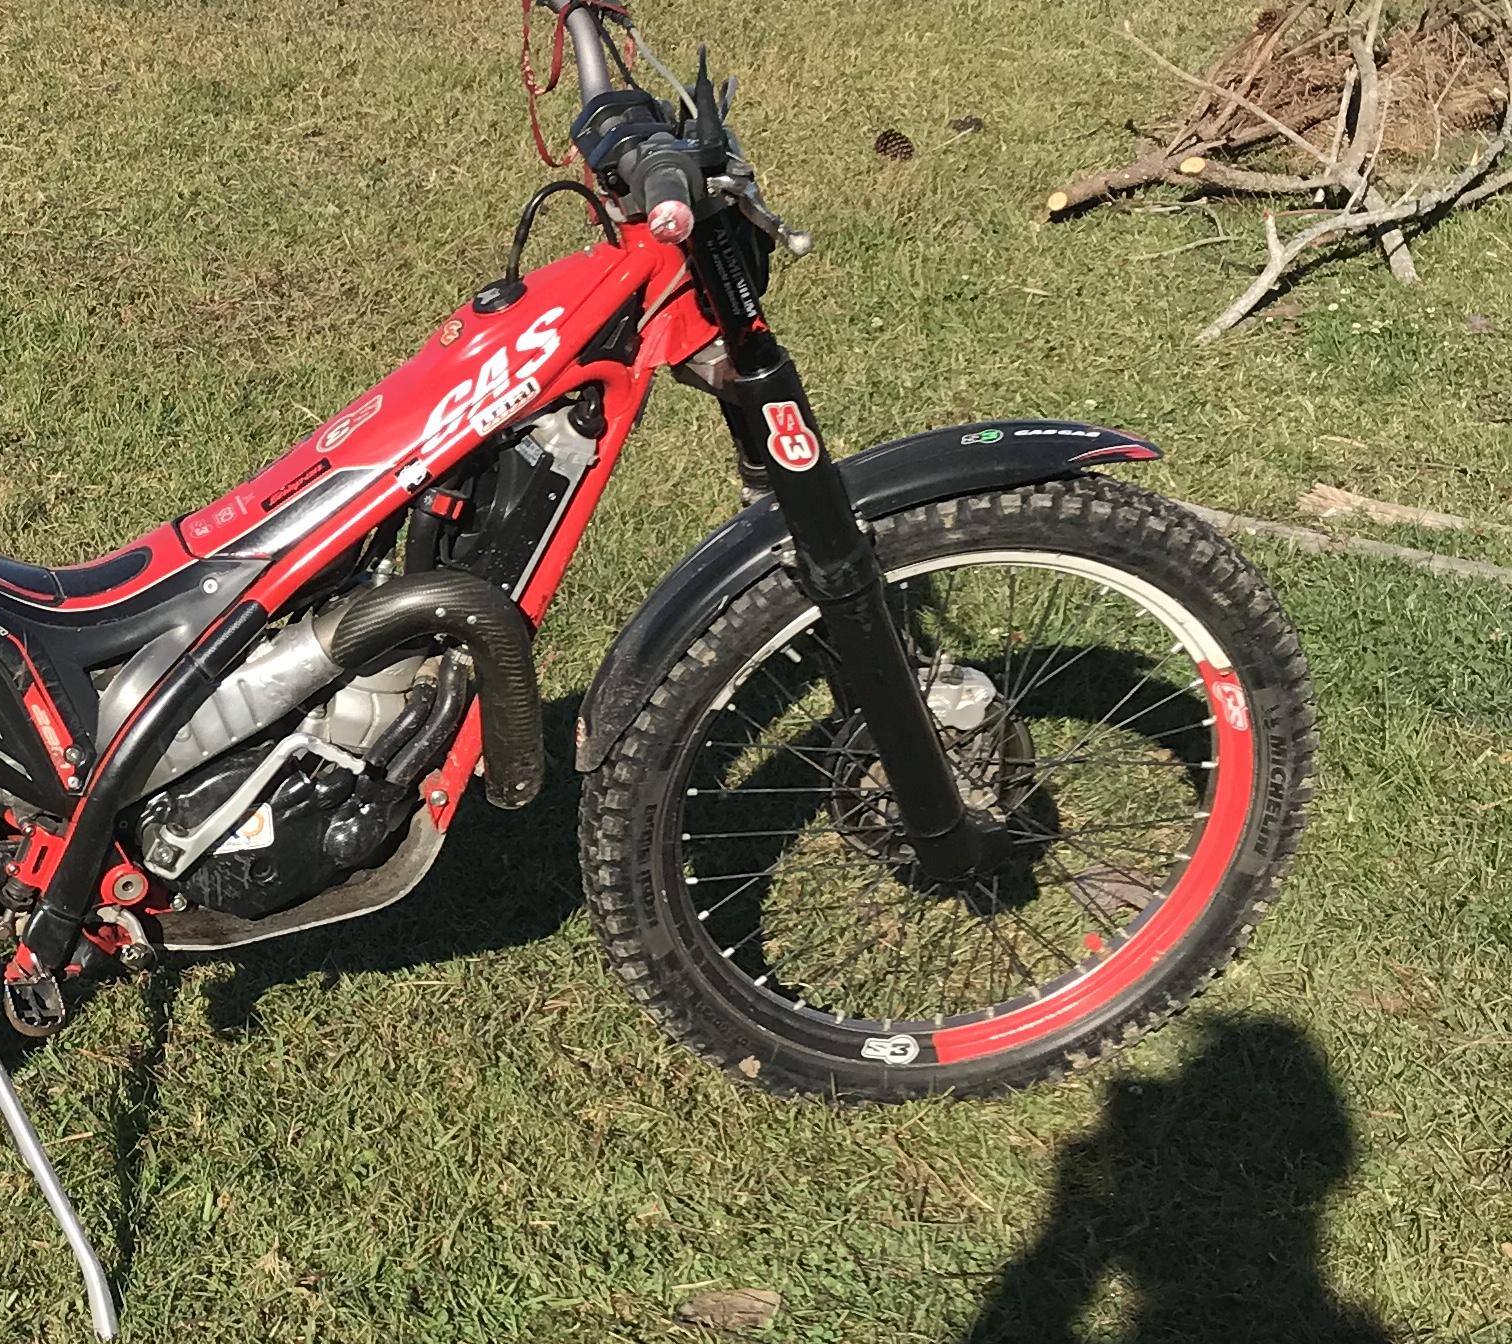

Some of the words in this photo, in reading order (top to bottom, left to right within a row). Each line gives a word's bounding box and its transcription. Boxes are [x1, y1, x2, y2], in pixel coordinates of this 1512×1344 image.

[764, 403, 817, 468] S3
[1254, 734, 1287, 857] MICHELIN
[861, 1034, 920, 1064] S3
